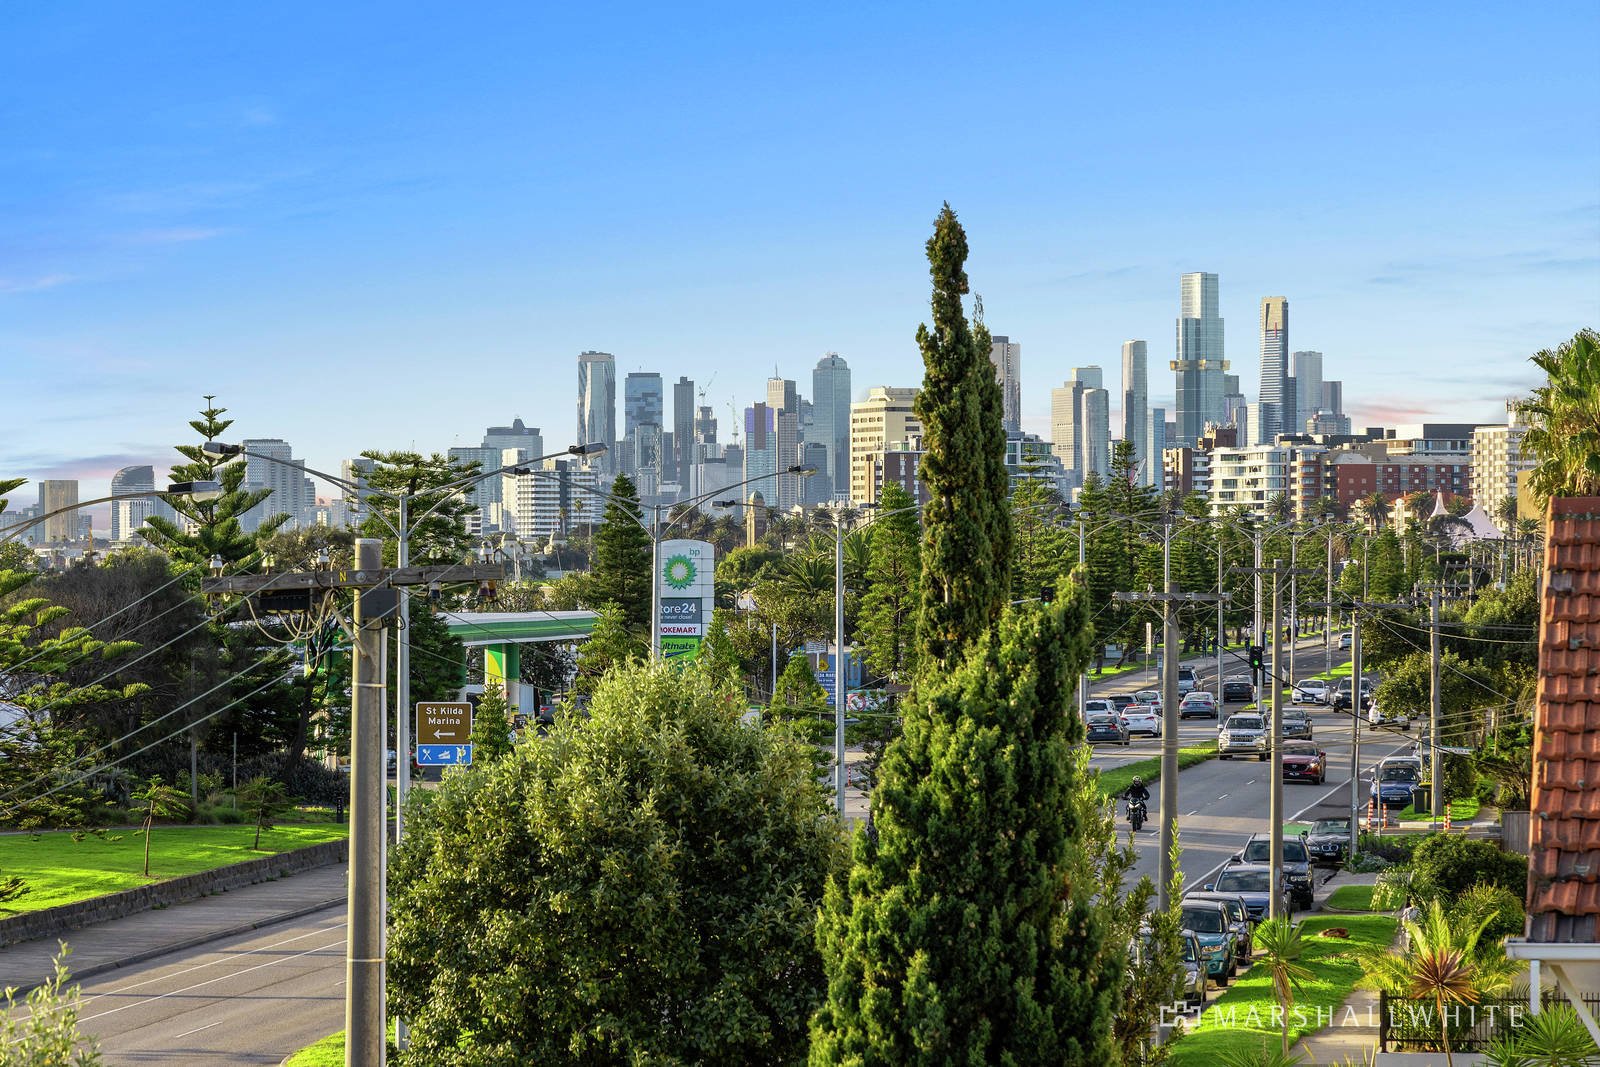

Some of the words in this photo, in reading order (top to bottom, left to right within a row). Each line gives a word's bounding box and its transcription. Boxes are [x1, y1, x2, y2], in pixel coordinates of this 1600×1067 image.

[689, 548, 700, 556] bp
[340, 571, 346, 582] N
[426, 707, 436, 715] St
[440, 707, 463, 715] Kilda
[428, 717, 461, 725] Marina
